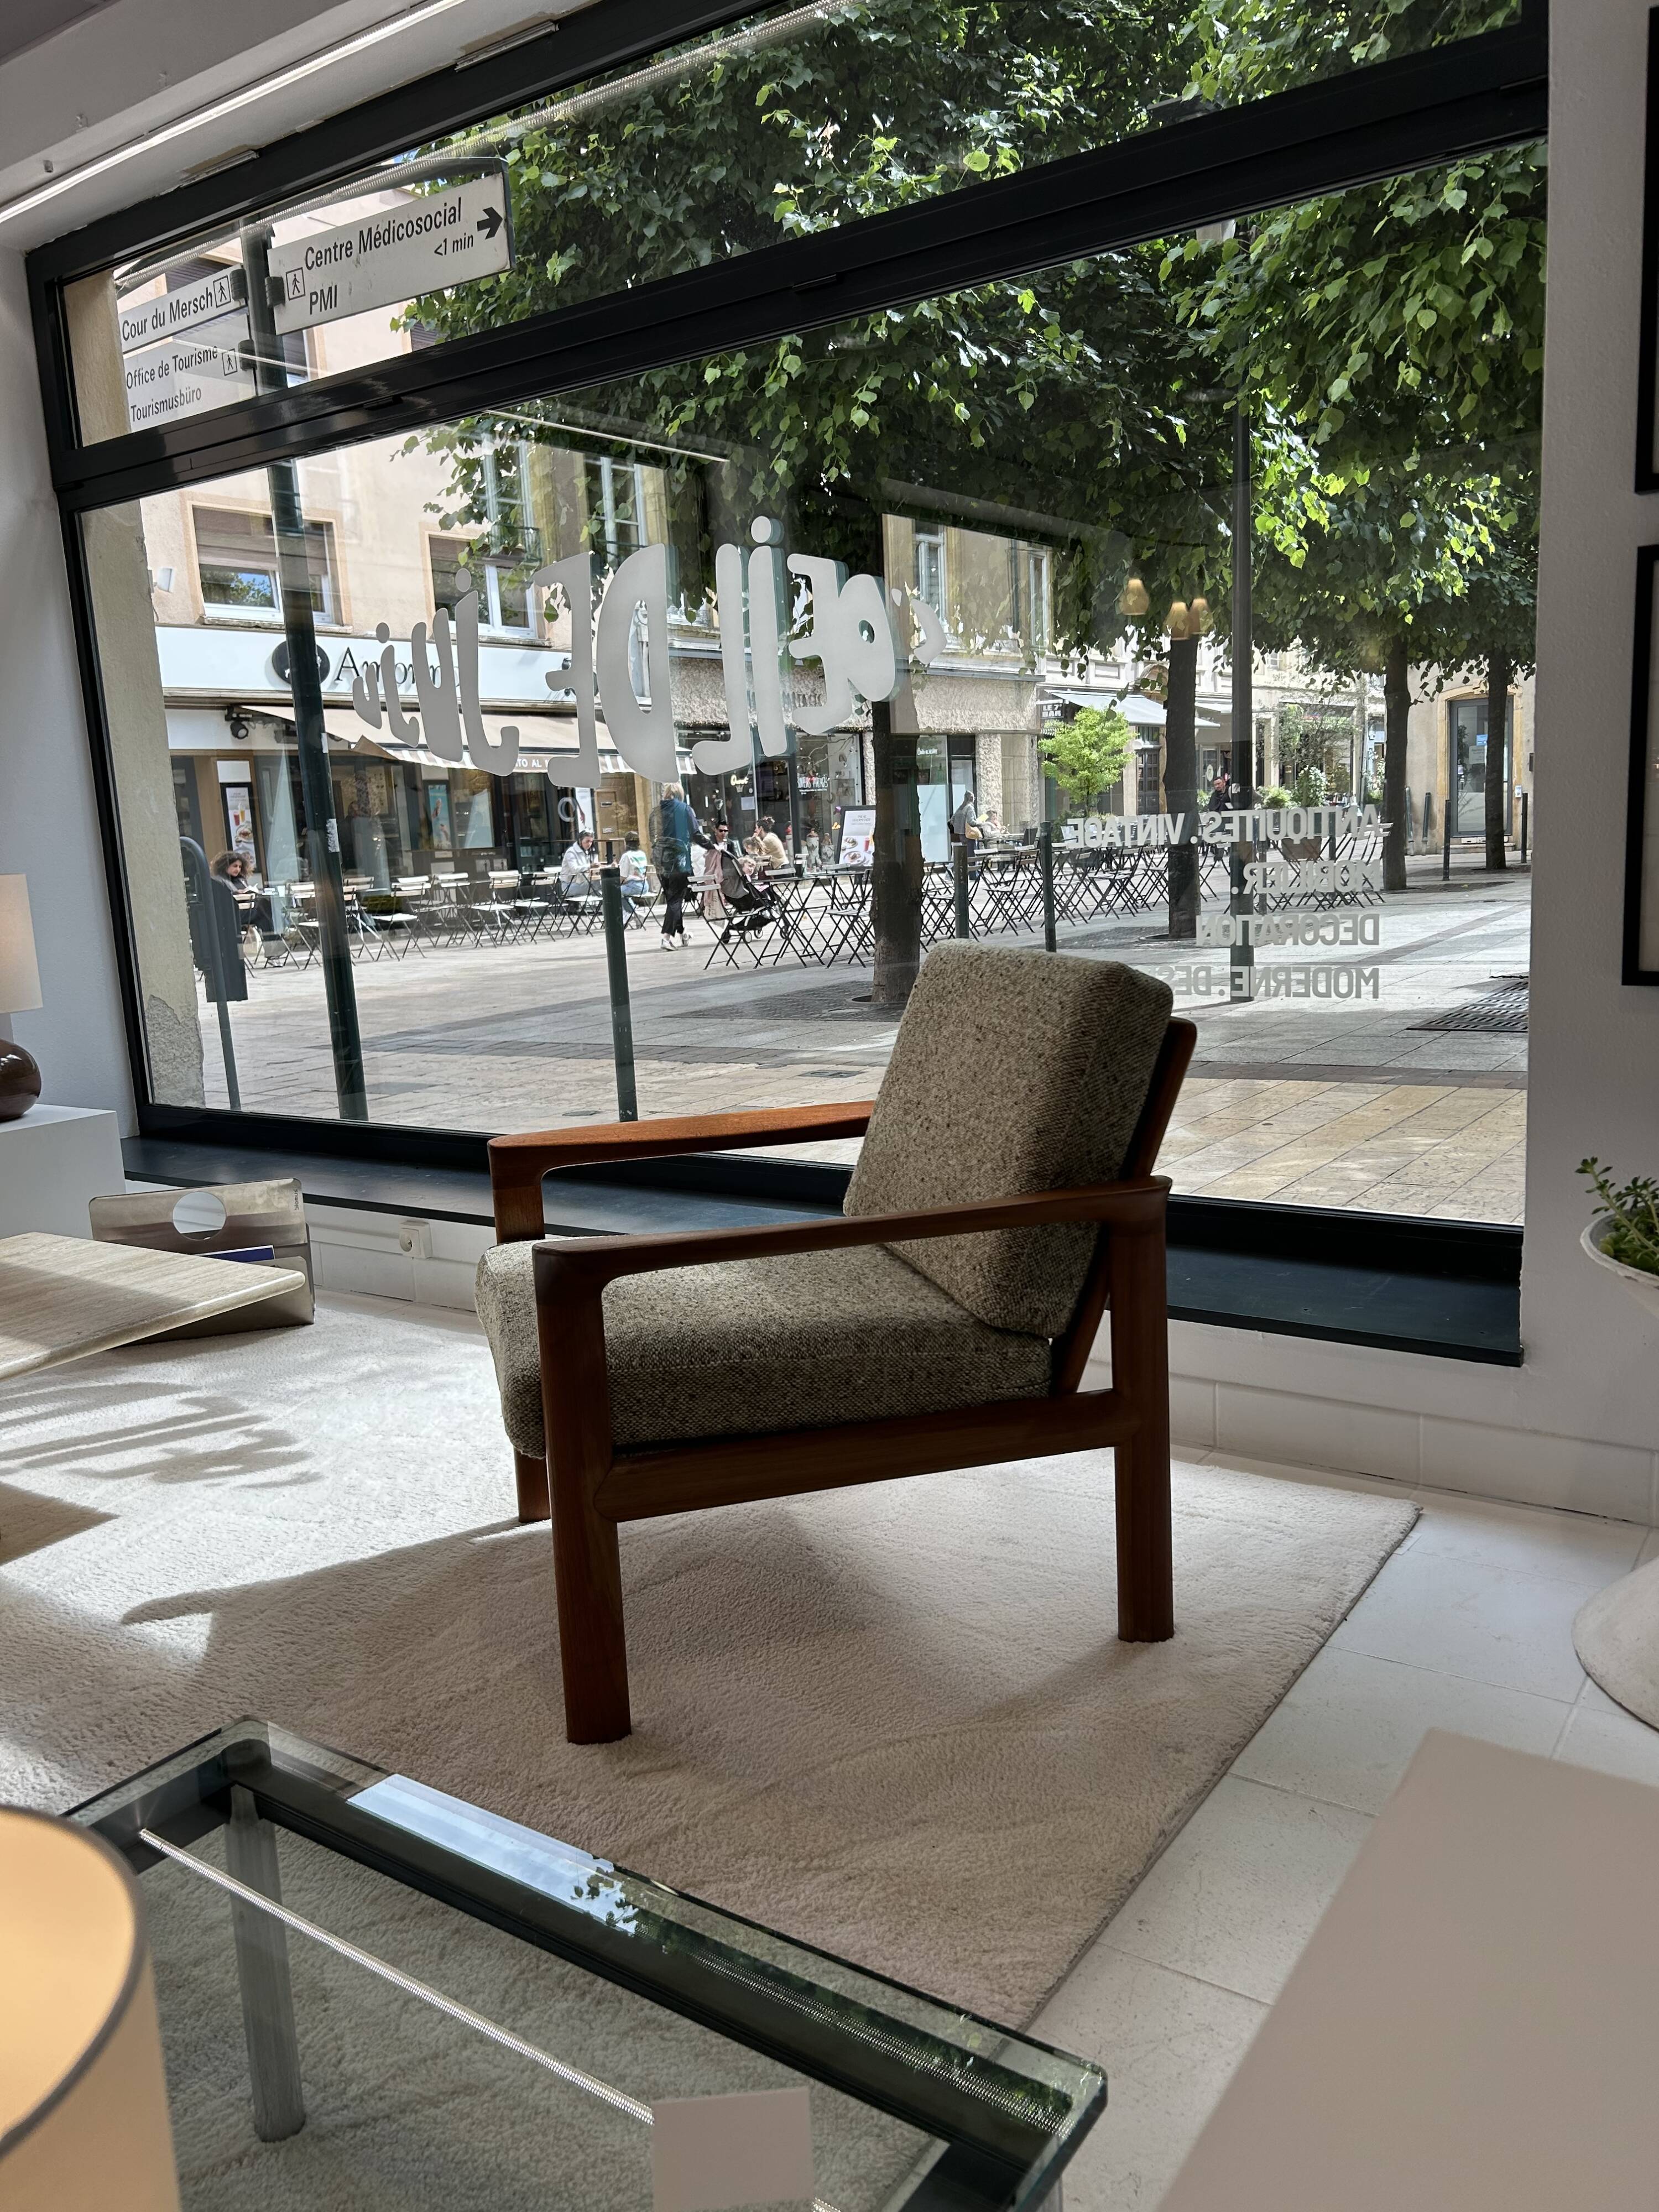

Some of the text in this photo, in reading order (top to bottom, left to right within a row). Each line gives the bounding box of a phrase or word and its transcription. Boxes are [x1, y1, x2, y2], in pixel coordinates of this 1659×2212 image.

[305, 197, 461, 270] Centre Médicosocial
[452, 233, 474, 253] min
[122, 287, 213, 341] Cour du Mersch
[310, 285, 337, 315] PMI
[126, 346, 218, 389] Office de Tourisme
[131, 387, 201, 422] Tourismusbüro
